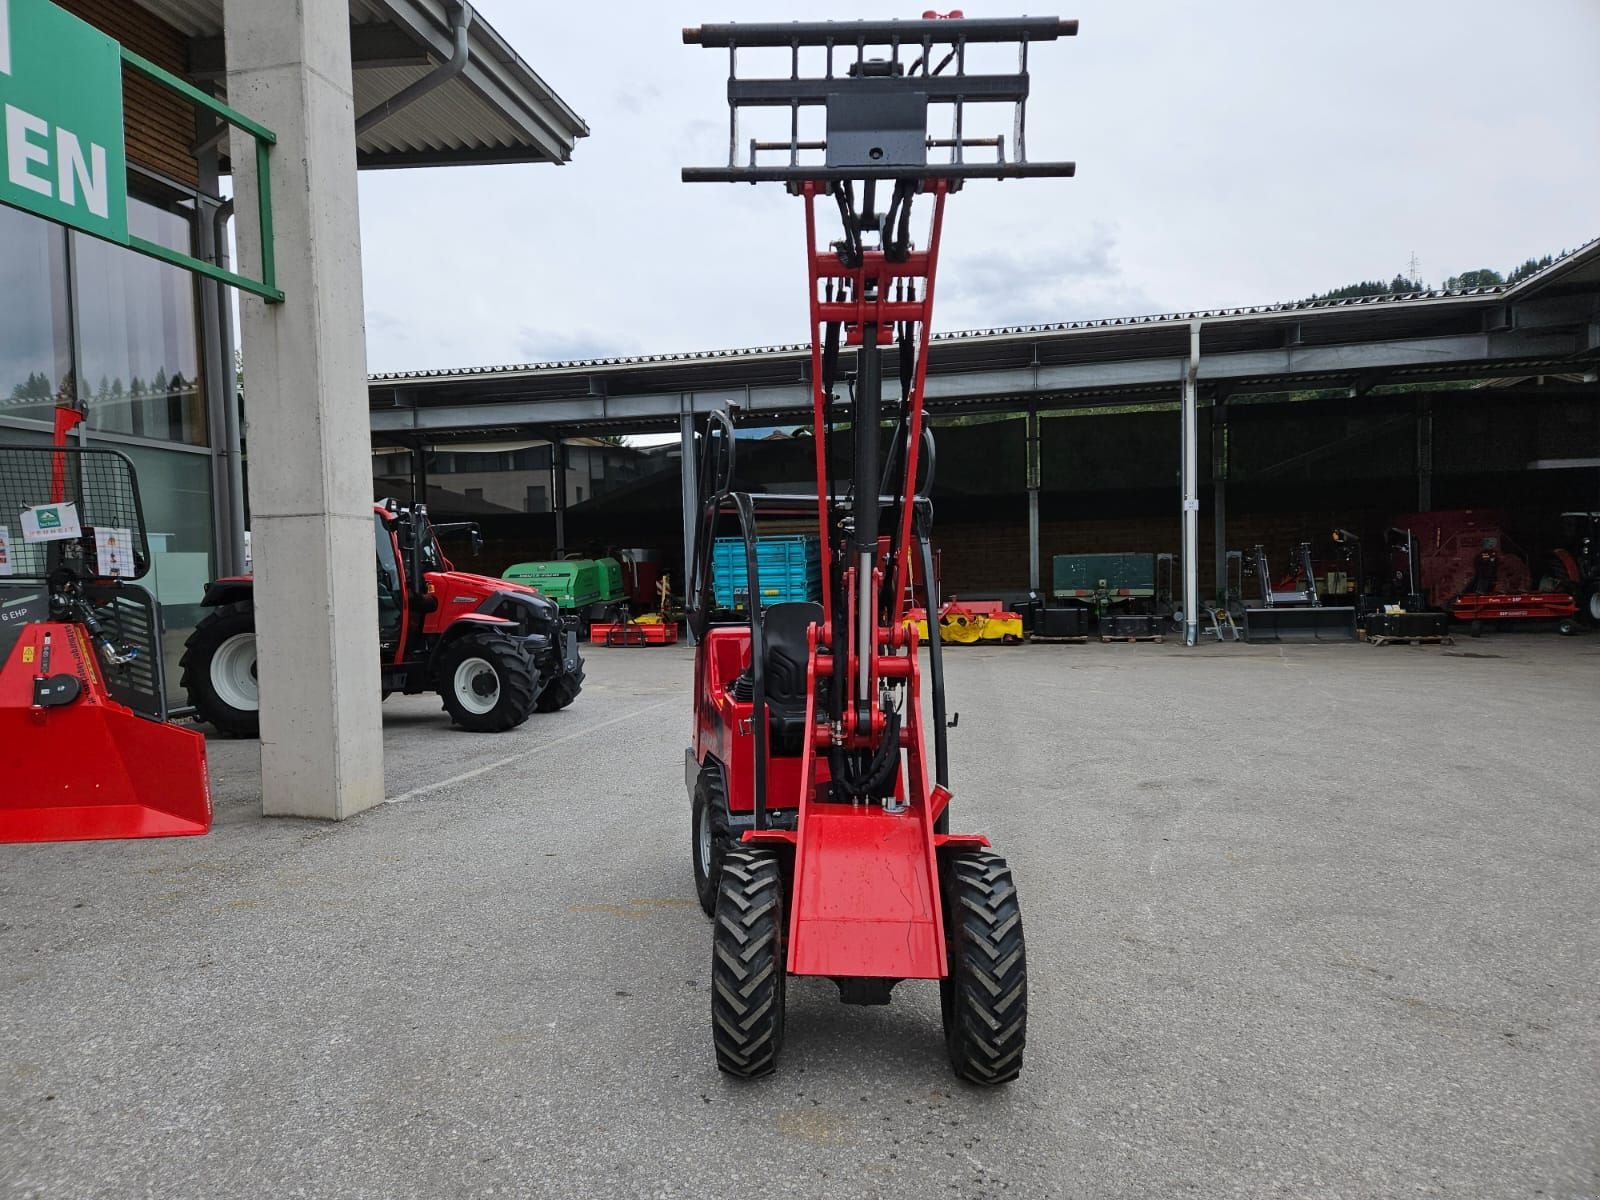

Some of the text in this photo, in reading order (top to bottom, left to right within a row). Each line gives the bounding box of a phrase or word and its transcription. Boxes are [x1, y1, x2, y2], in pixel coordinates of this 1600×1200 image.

[5, 103, 109, 219] EN
[1, 608, 28, 621] 6 EHP
